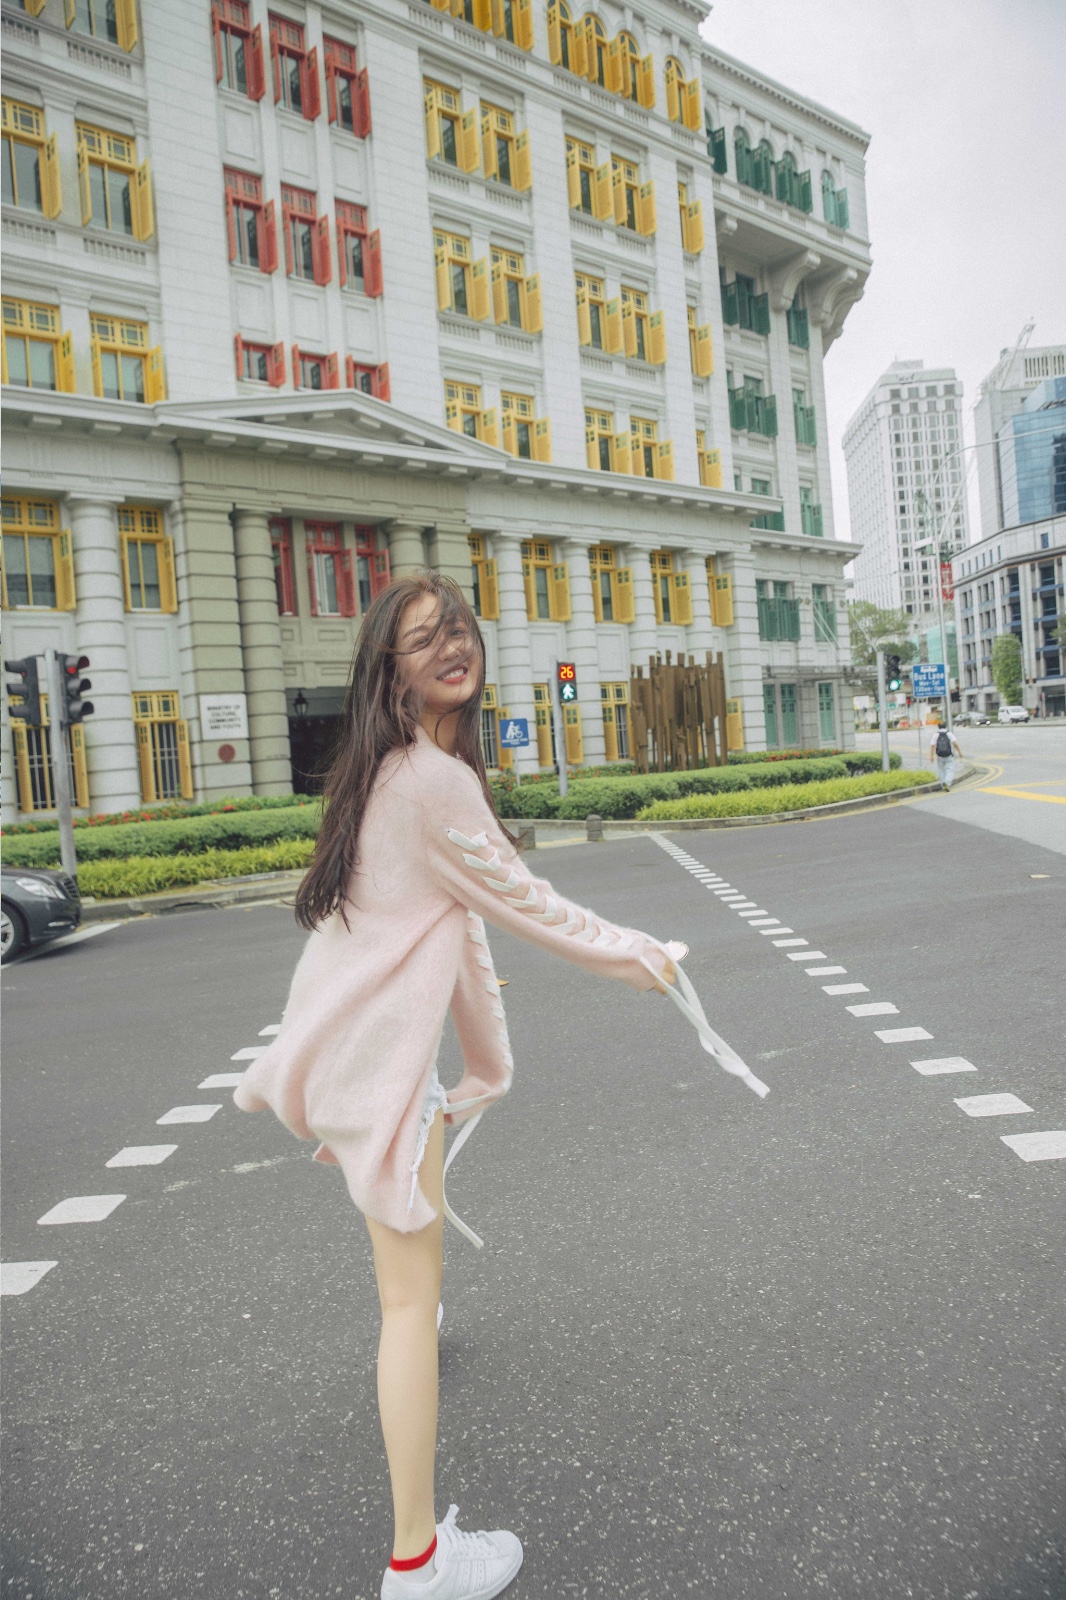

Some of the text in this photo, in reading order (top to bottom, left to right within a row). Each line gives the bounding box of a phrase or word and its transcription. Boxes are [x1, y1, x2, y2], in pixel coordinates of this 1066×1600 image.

[560, 666, 574, 679] 26
[913, 672, 945, 681] Bus Lane
